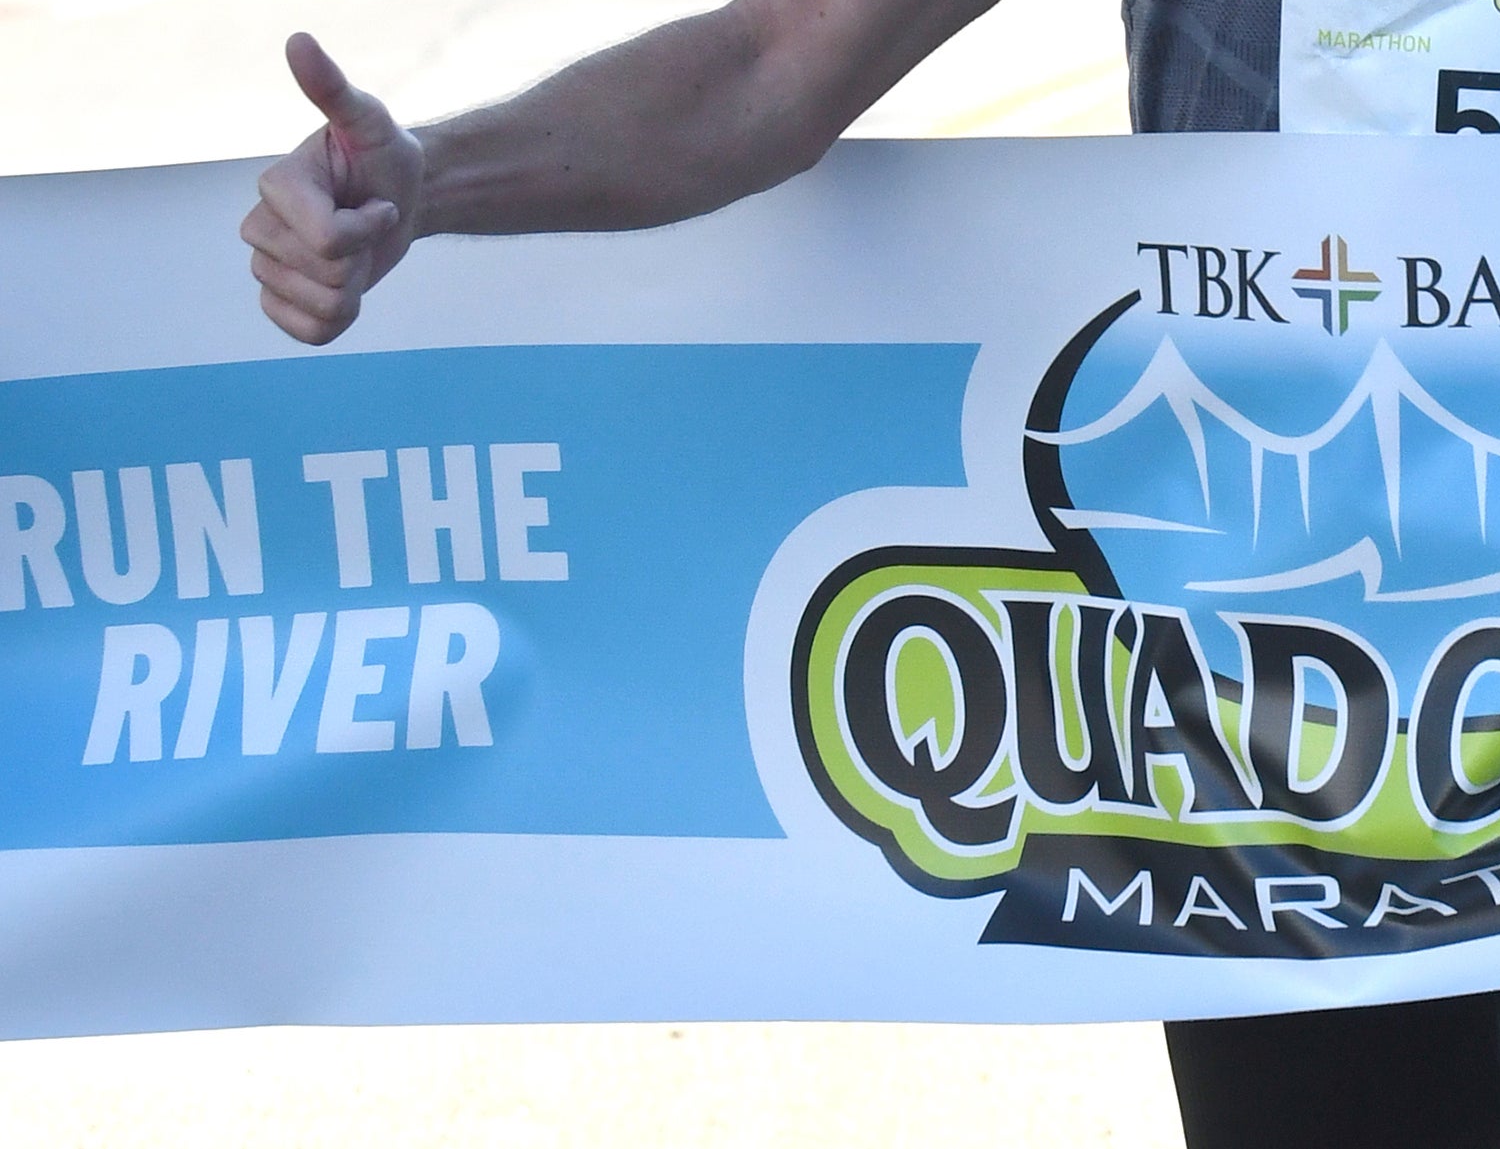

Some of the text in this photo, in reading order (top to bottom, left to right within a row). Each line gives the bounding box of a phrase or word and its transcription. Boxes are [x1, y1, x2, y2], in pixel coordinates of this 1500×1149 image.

[1317, 29, 1432, 53] MARATHON
[1137, 242, 1292, 324] TBK
[0, 442, 570, 612] RUN THE
[82, 601, 501, 766] RIVER
[835, 589, 1398, 846] QUAD
